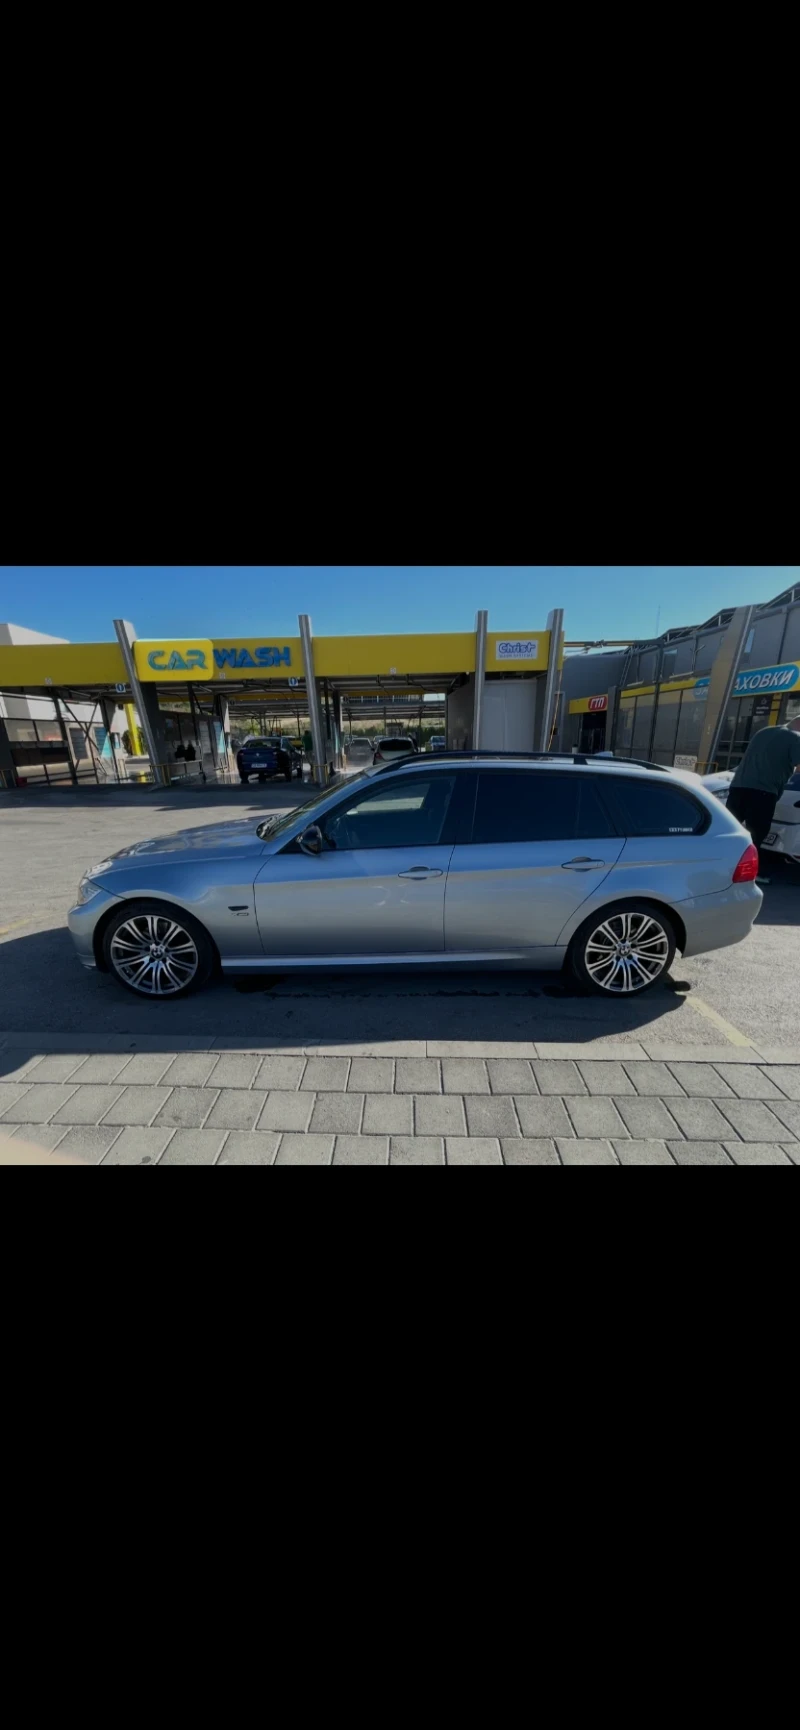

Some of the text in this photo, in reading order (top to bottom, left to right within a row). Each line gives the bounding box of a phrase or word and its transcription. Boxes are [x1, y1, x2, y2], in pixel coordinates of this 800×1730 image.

[499, 641, 536, 653] Christ
[148, 647, 291, 670] CAR WASH
